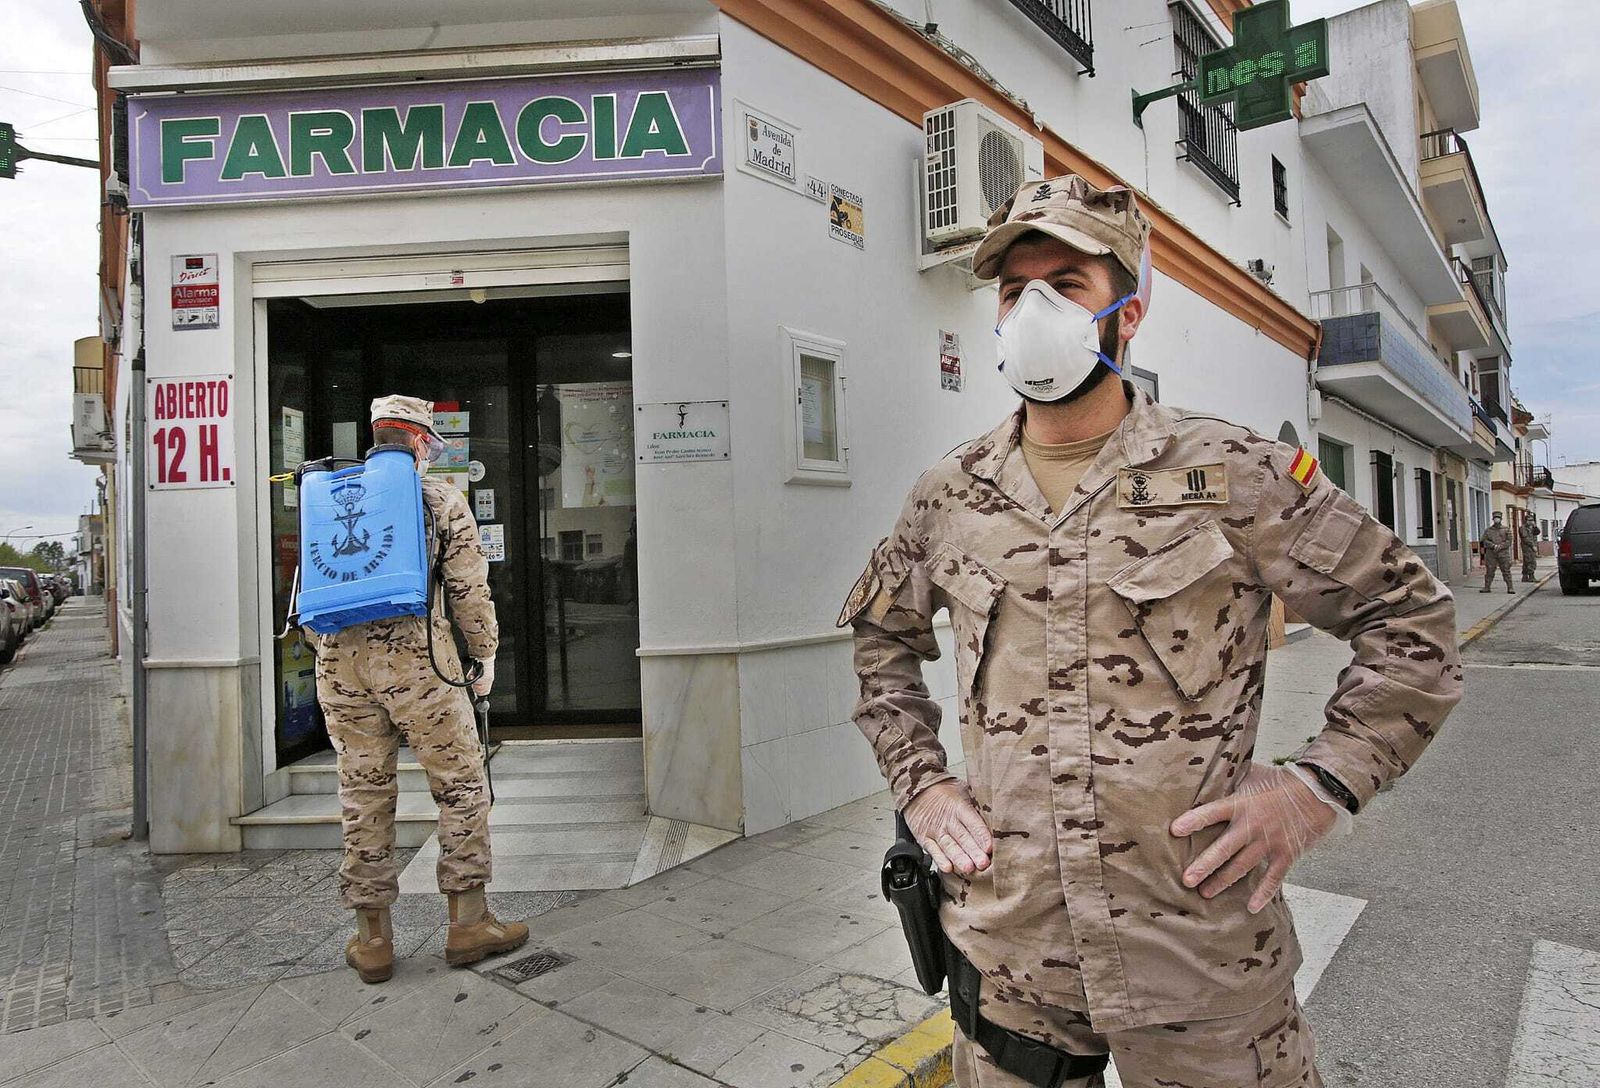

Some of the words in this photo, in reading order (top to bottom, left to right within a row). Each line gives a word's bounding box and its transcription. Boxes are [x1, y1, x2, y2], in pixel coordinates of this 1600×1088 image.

[160, 90, 692, 185] FARMACIA
[762, 125, 792, 147] Avenida
[772, 144, 782, 156] de
[753, 149, 791, 176] Madrid
[831, 184, 863, 204] CONECTADA
[831, 225, 864, 245] PROSEGUR
[175, 287, 217, 298] Alarma
[155, 380, 228, 420] ABIERTO
[653, 430, 716, 440] FARMACIA
[153, 426, 187, 483] 12
[199, 424, 231, 482] H.
[1181, 490, 1205, 501] MESA
[310, 540, 338, 580] TERCIO
[341, 571, 358, 582] DE
[363, 524, 394, 577] ARMADA
